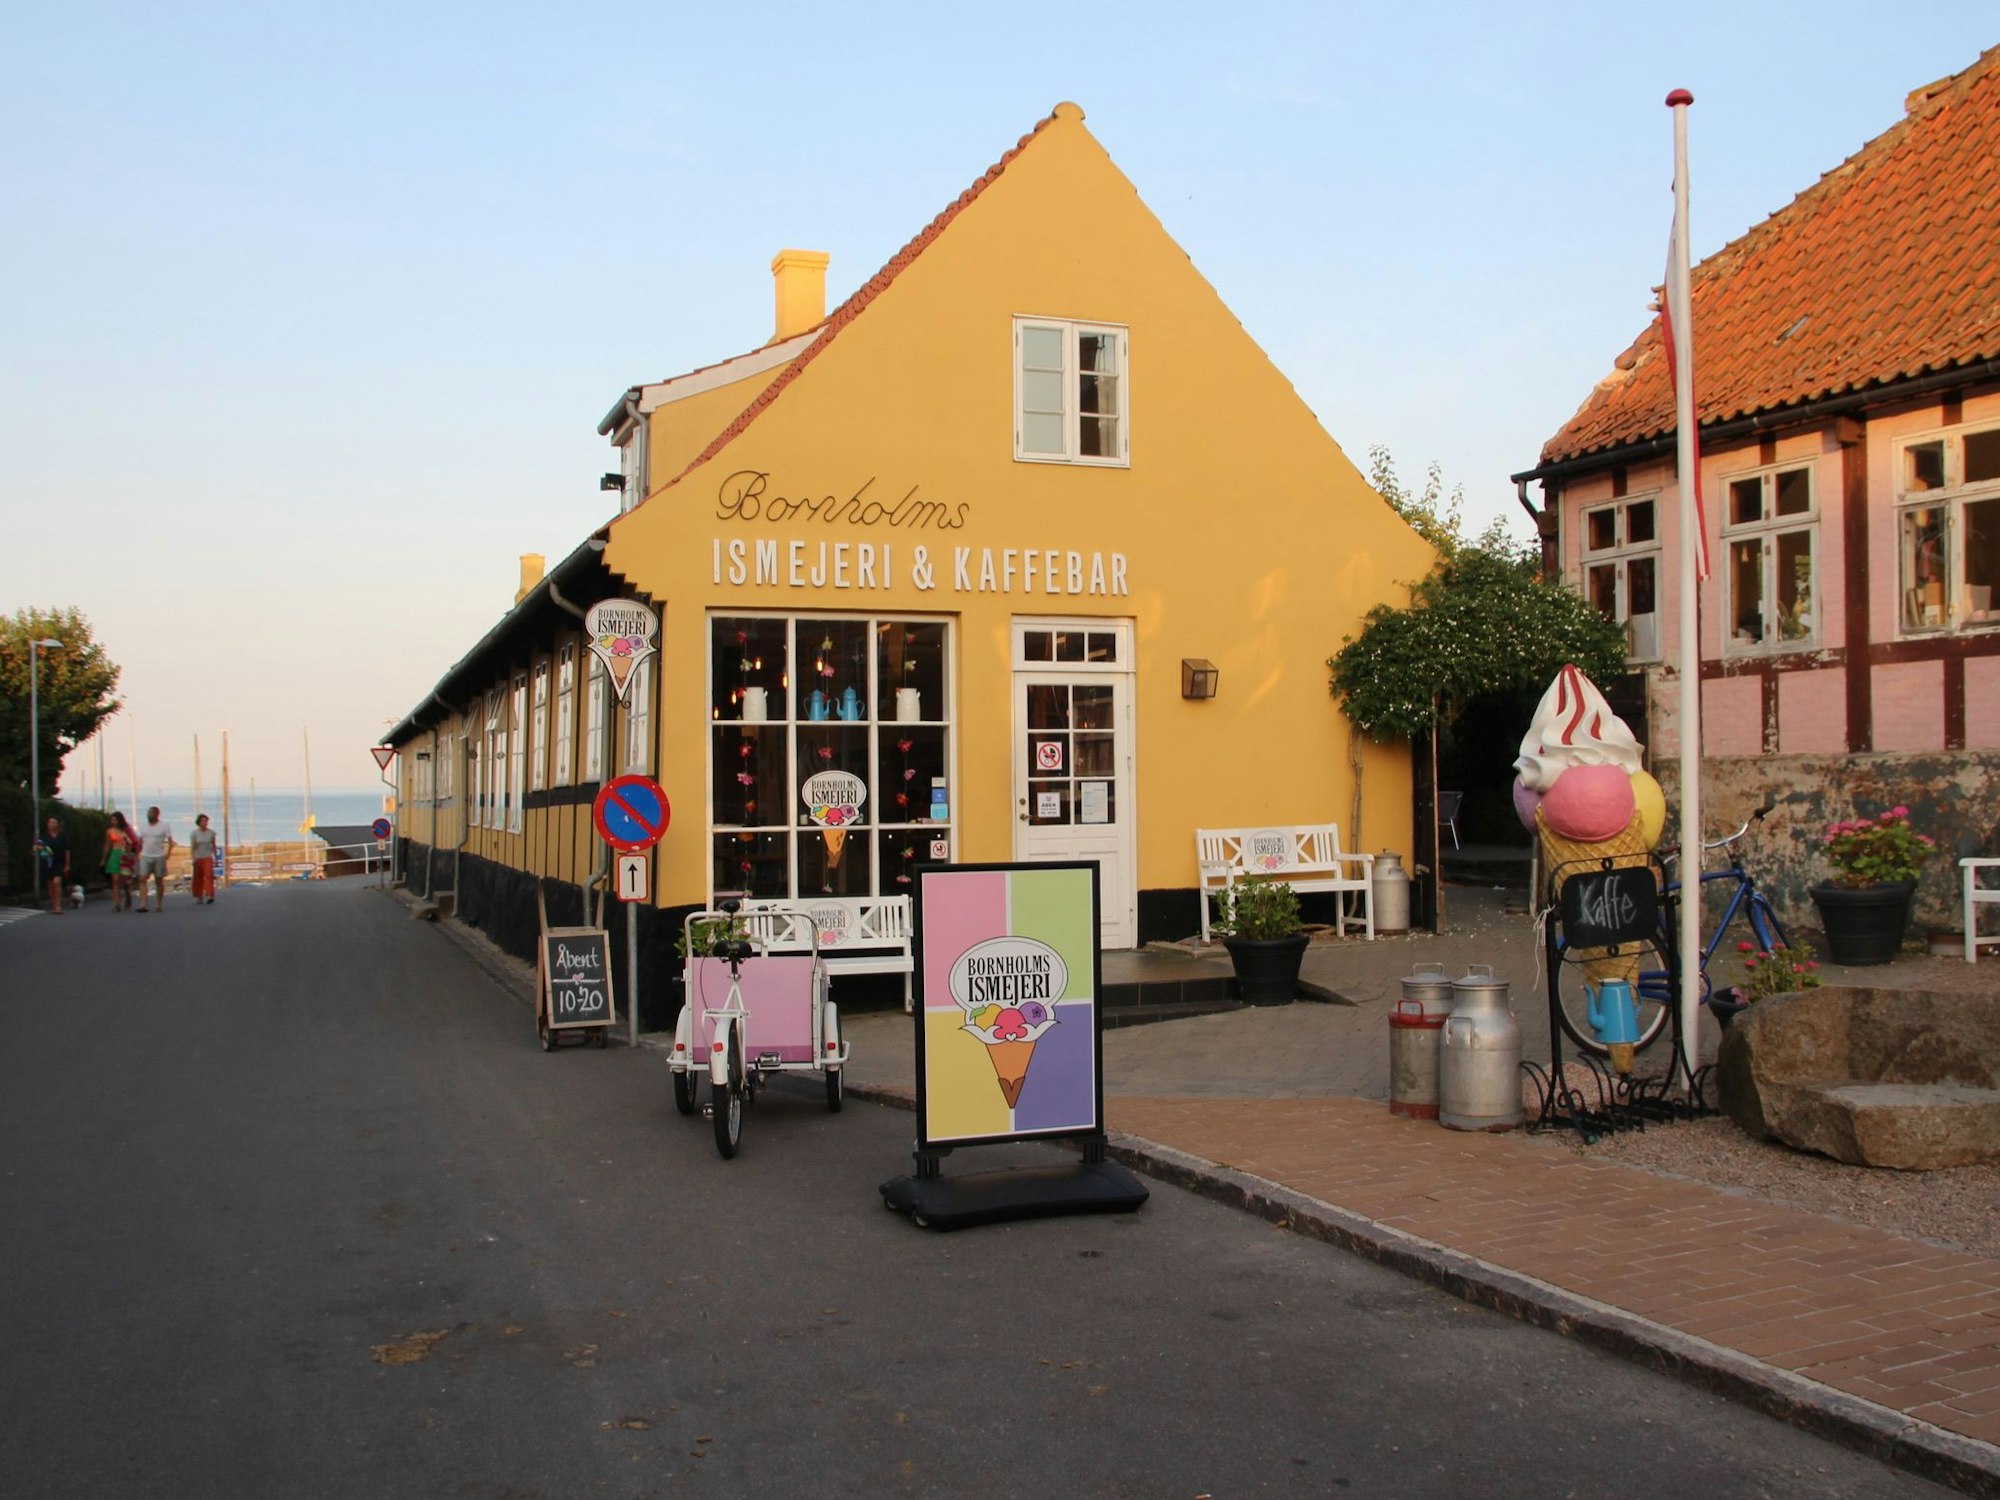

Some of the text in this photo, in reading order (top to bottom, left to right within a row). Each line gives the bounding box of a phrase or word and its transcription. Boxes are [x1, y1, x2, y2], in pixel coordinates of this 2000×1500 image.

[716, 470, 970, 529] Bornholms
[713, 538, 1129, 596] ISMEJERI & KAFFEBAR
[598, 608, 647, 622] BORNHOLMS
[597, 620, 646, 637] ISMEJERI
[811, 780, 858, 791] BORNHOLMS
[812, 790, 857, 806] ISMEJERI
[1578, 875, 1638, 930] Kaffe
[556, 943, 600, 969] Åbent
[967, 954, 1050, 976] BORNHOLMS
[559, 986, 603, 1014] 10-20
[967, 973, 1050, 1006] ISMEJERI
